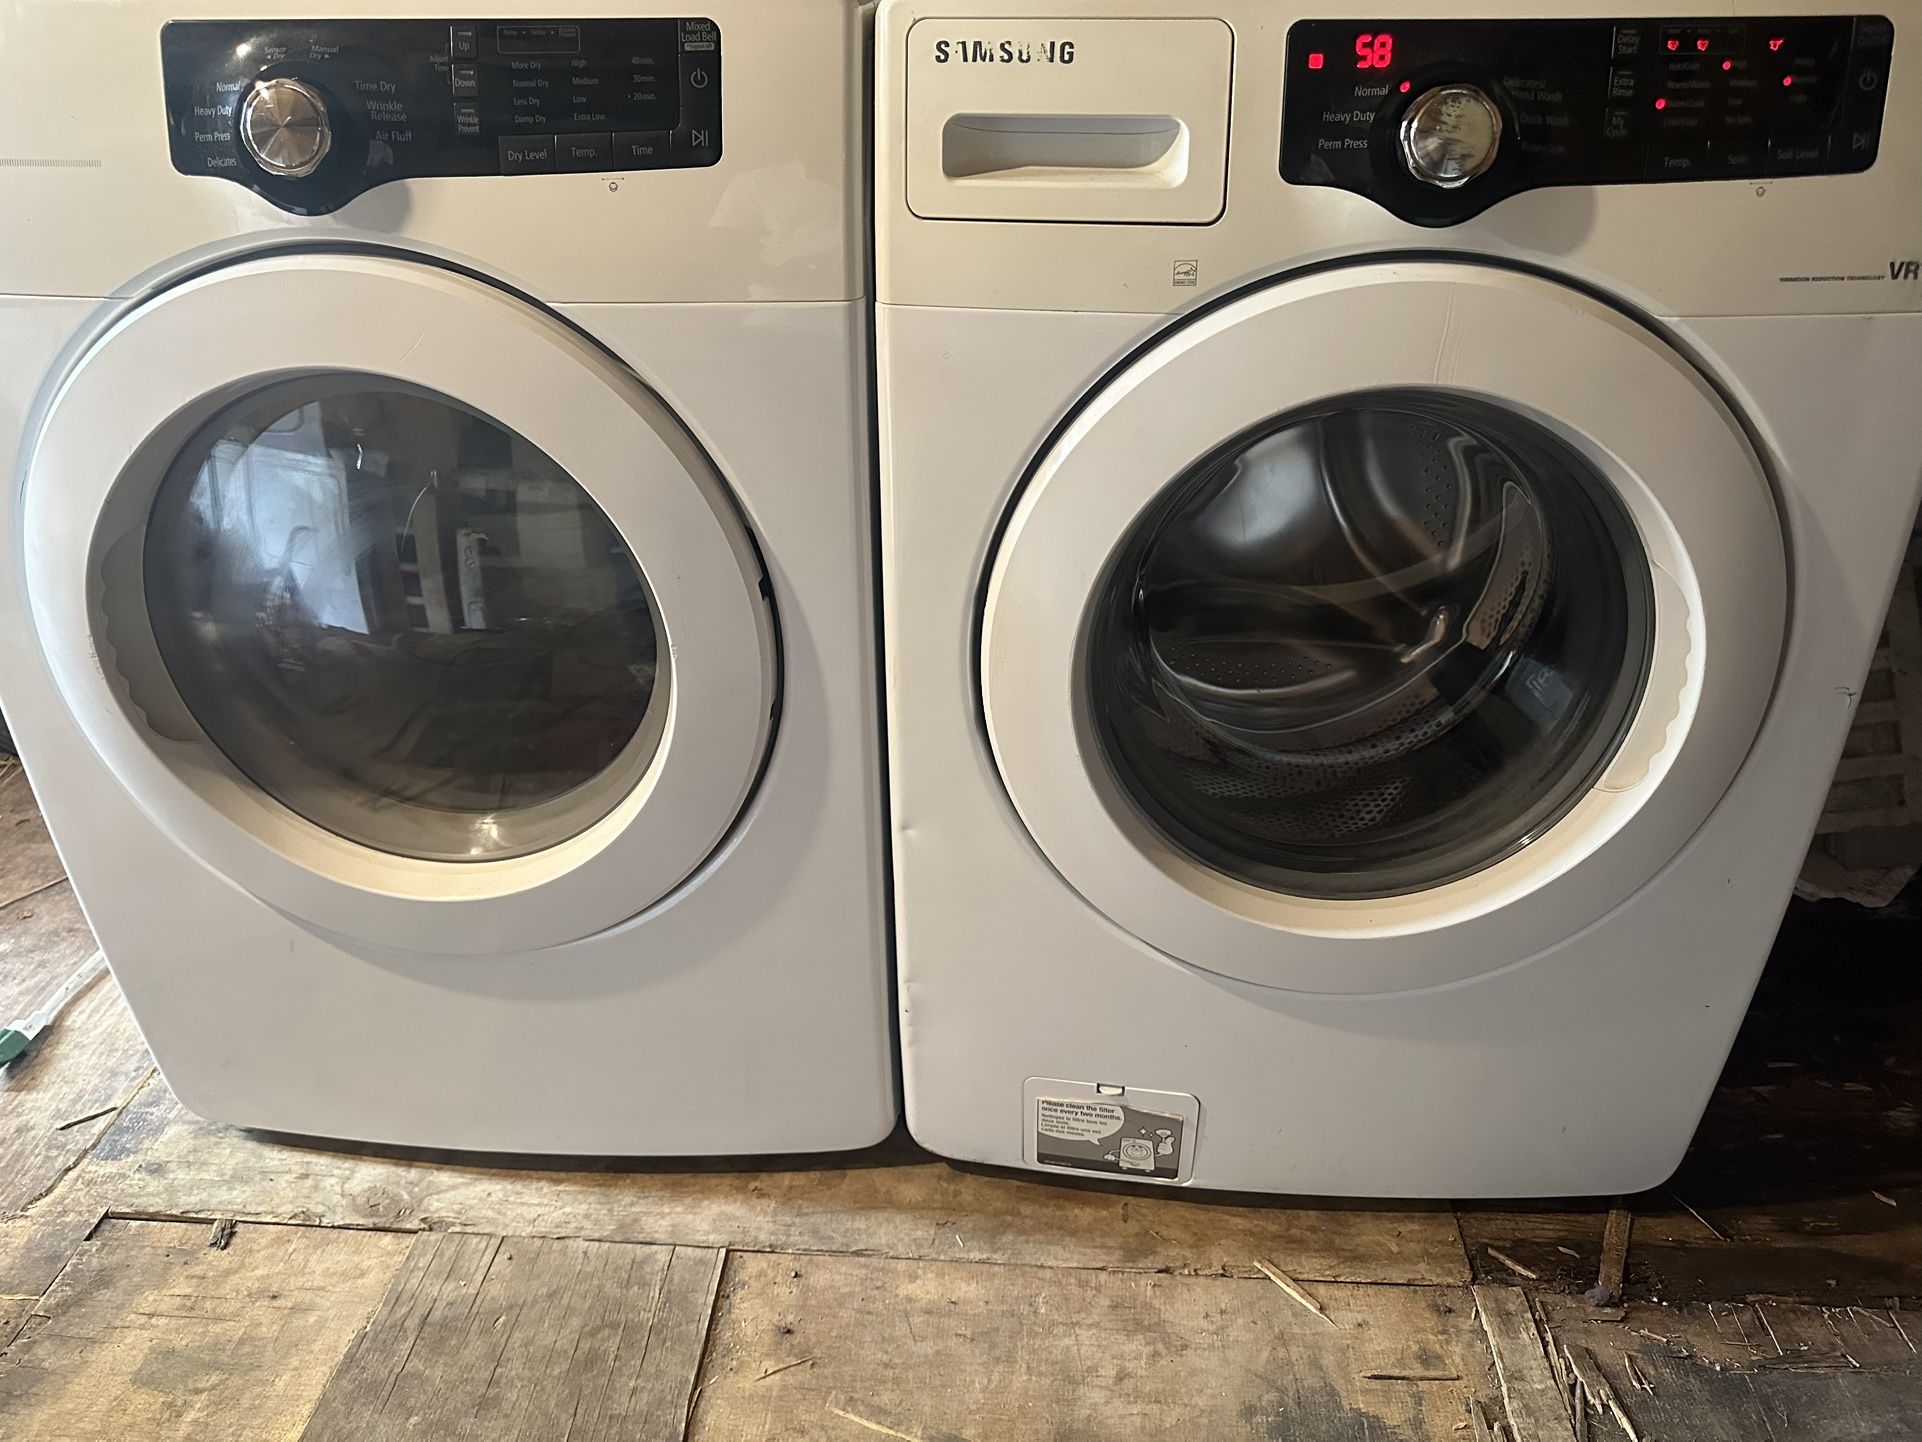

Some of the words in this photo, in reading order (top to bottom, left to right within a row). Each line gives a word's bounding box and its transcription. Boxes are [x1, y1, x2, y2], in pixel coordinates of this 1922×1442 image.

[686, 21, 711, 32] Mixed
[681, 32, 700, 42] Load
[702, 31, 717, 42] Bell
[458, 41, 470, 52] Up
[1355, 34, 1393, 68] 58
[511, 61, 528, 70] More
[529, 60, 542, 71] Dry
[571, 58, 587, 69] High
[216, 81, 242, 92] Normal
[354, 80, 378, 91] Time
[379, 80, 396, 94] Dry
[455, 78, 476, 88] Down
[512, 79, 535, 88] Normal
[536, 78, 550, 90] Dry
[572, 77, 599, 86] Medium
[1613, 78, 1634, 88] Extra
[1354, 85, 1389, 97] Normal
[1612, 88, 1633, 98] Rinse
[528, 96, 541, 107] Dry
[573, 95, 587, 103] Low
[194, 105, 216, 118] Heavy
[217, 105, 233, 117] Duty
[366, 100, 403, 112] Wrinkle
[371, 111, 408, 122] Release
[532, 114, 546, 126] Dry
[574, 113, 589, 121] Extra
[590, 113, 606, 121] Low
[1322, 111, 1351, 123] Heavy
[1352, 111, 1376, 123] Duty
[194, 132, 213, 142] Perm
[213, 131, 231, 142] Press
[375, 130, 390, 142] Air
[391, 131, 413, 142] Fluff
[1318, 138, 1342, 150] Perm
[1344, 138, 1368, 149] Press
[508, 150, 523, 163] Dry
[525, 149, 548, 161] Level
[571, 147, 598, 159] Temp.
[631, 145, 653, 156] Time
[207, 156, 237, 168] Delicates
[1889, 261, 1922, 281] VR
[1098, 1106, 1116, 1114] filter
[1094, 1113, 1122, 1121] months.
